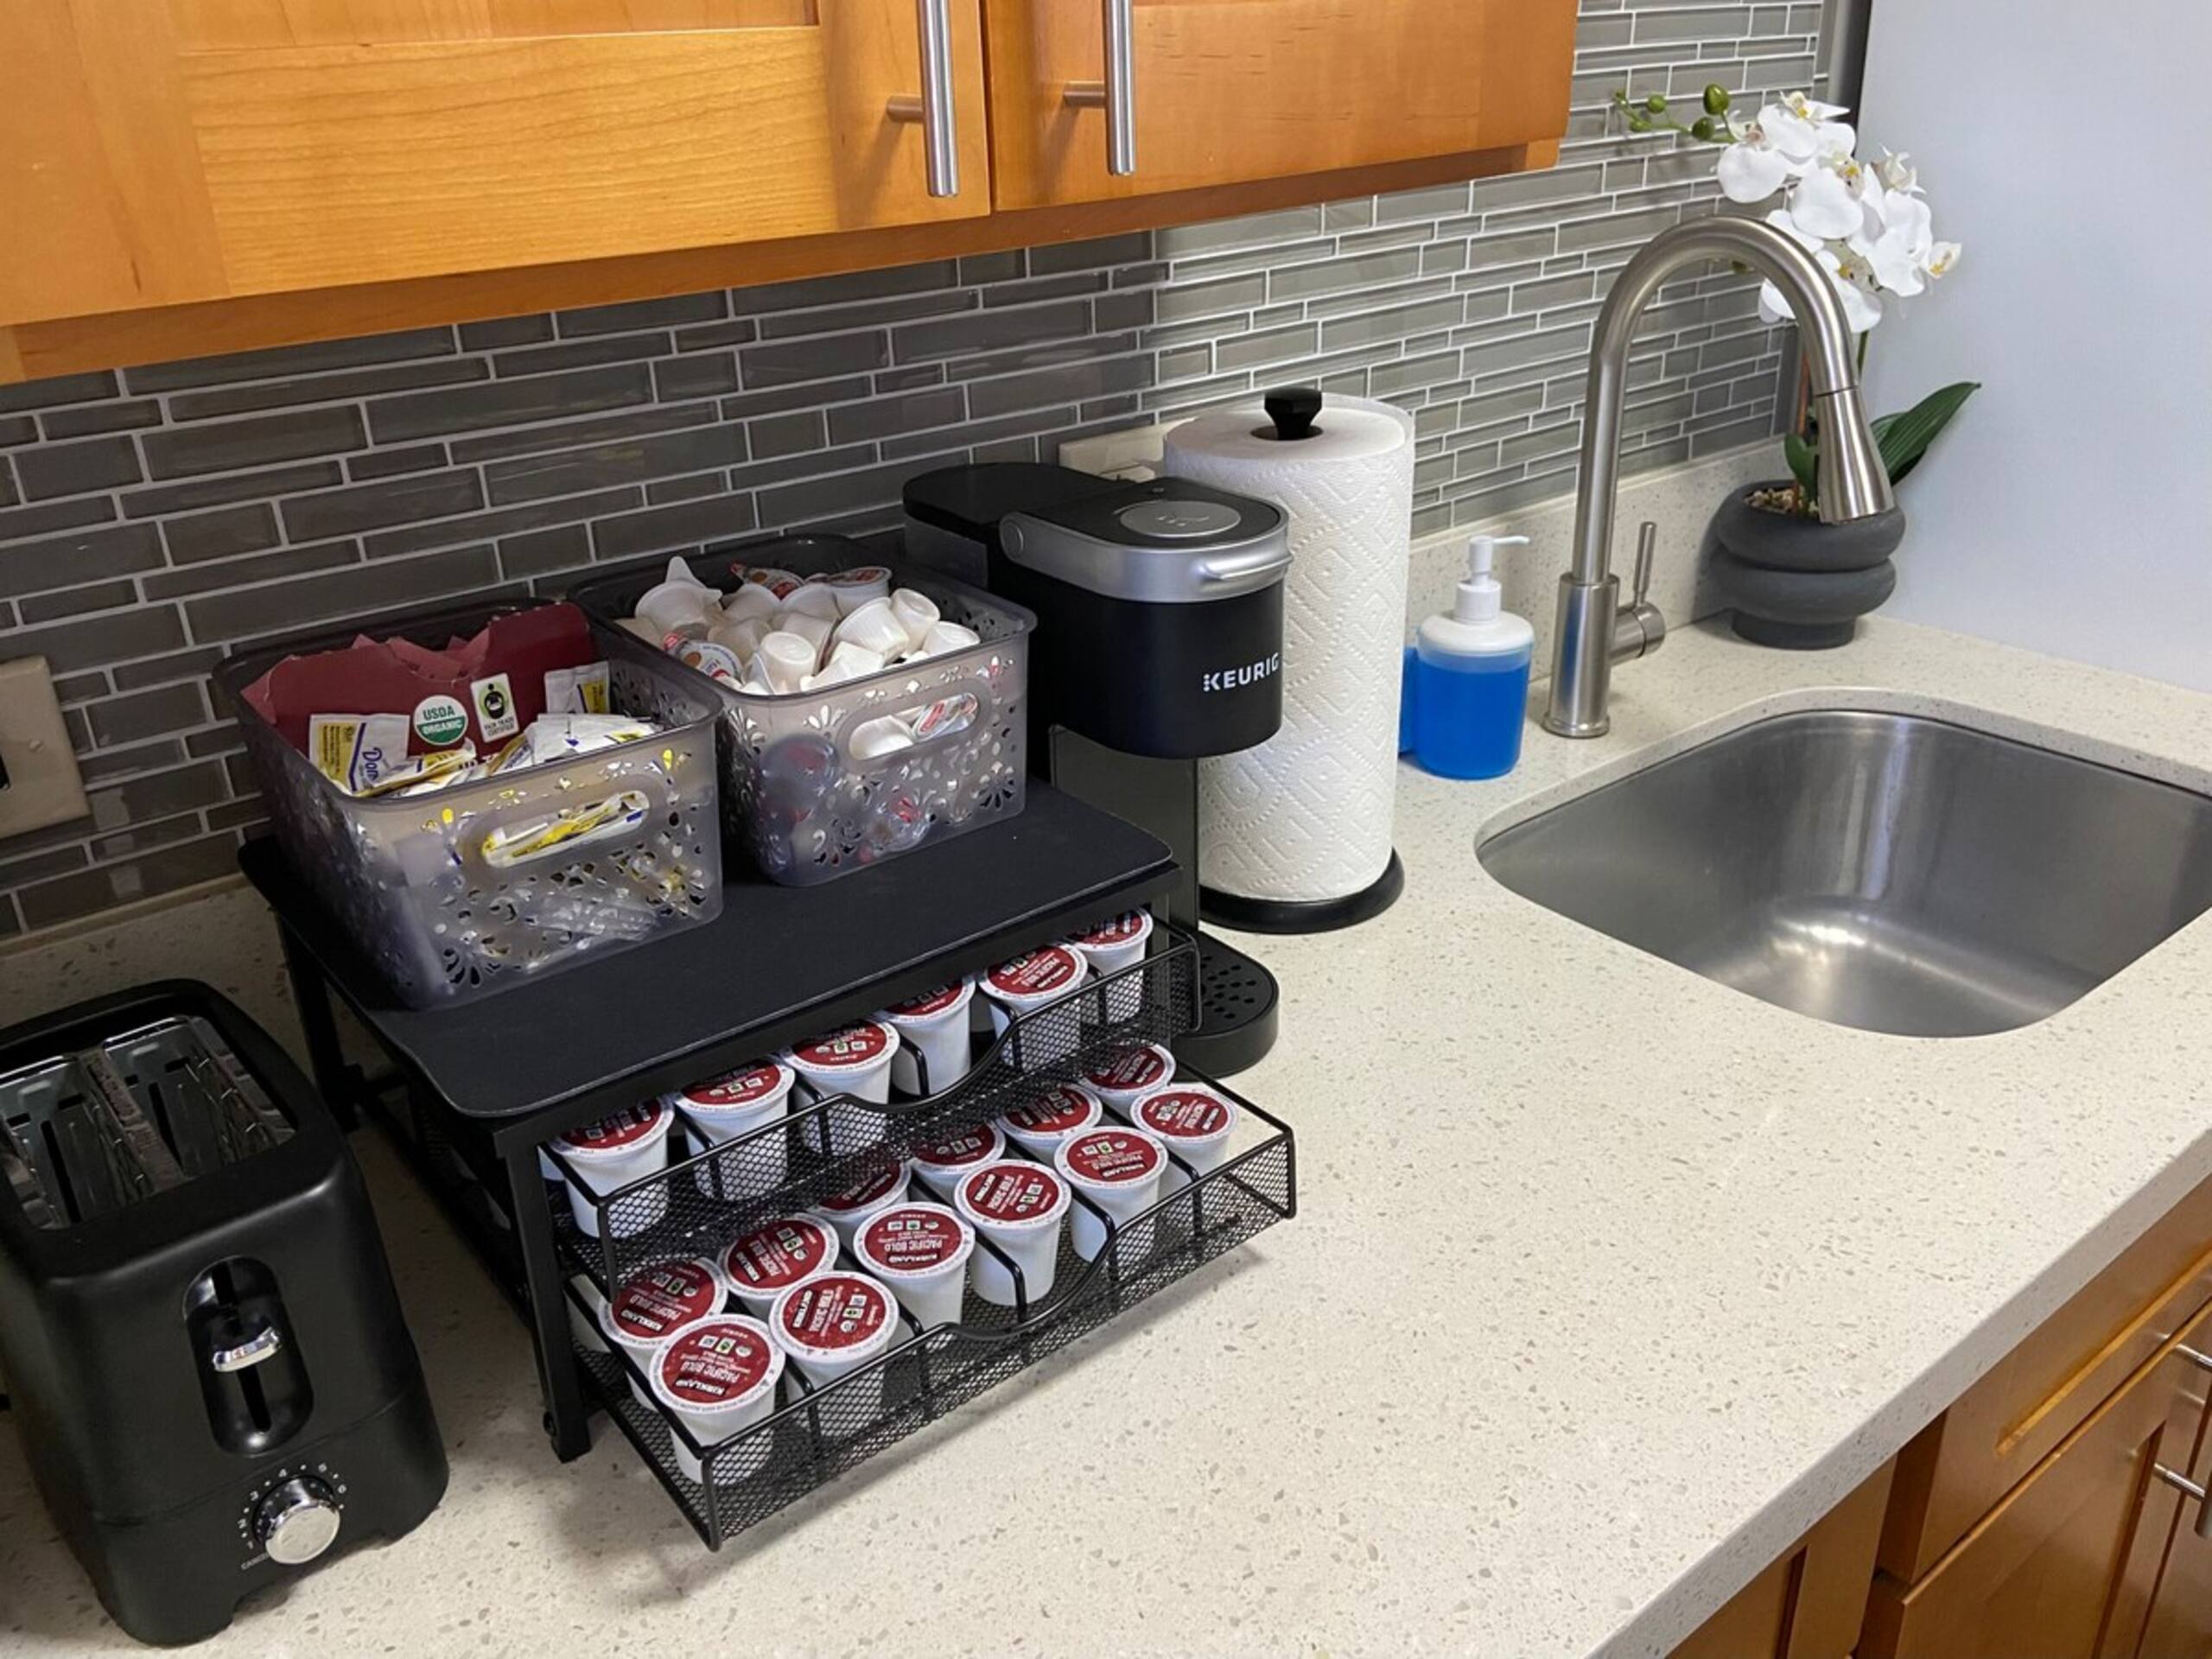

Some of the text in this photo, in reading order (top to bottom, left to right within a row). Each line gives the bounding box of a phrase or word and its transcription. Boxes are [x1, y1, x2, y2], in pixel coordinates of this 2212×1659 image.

[1203, 652, 1279, 692] KEURIG
[423, 705, 456, 721] USDA
[423, 718, 464, 734] ORGANIC
[362, 747, 383, 781] Dom
[885, 1239, 943, 1252] PACIFIC BOLD
[621, 1309, 663, 1331] KIRKLAND
[649, 1304, 682, 1320] PACIFIC
[680, 1361, 741, 1383] PACIFIC BOLD
[676, 1379, 725, 1395] KIRKLAND
[278, 1468, 288, 1478] 4
[250, 1491, 259, 1502] 3
[238, 1518, 247, 1529] 2
[247, 1541, 254, 1549] 1
